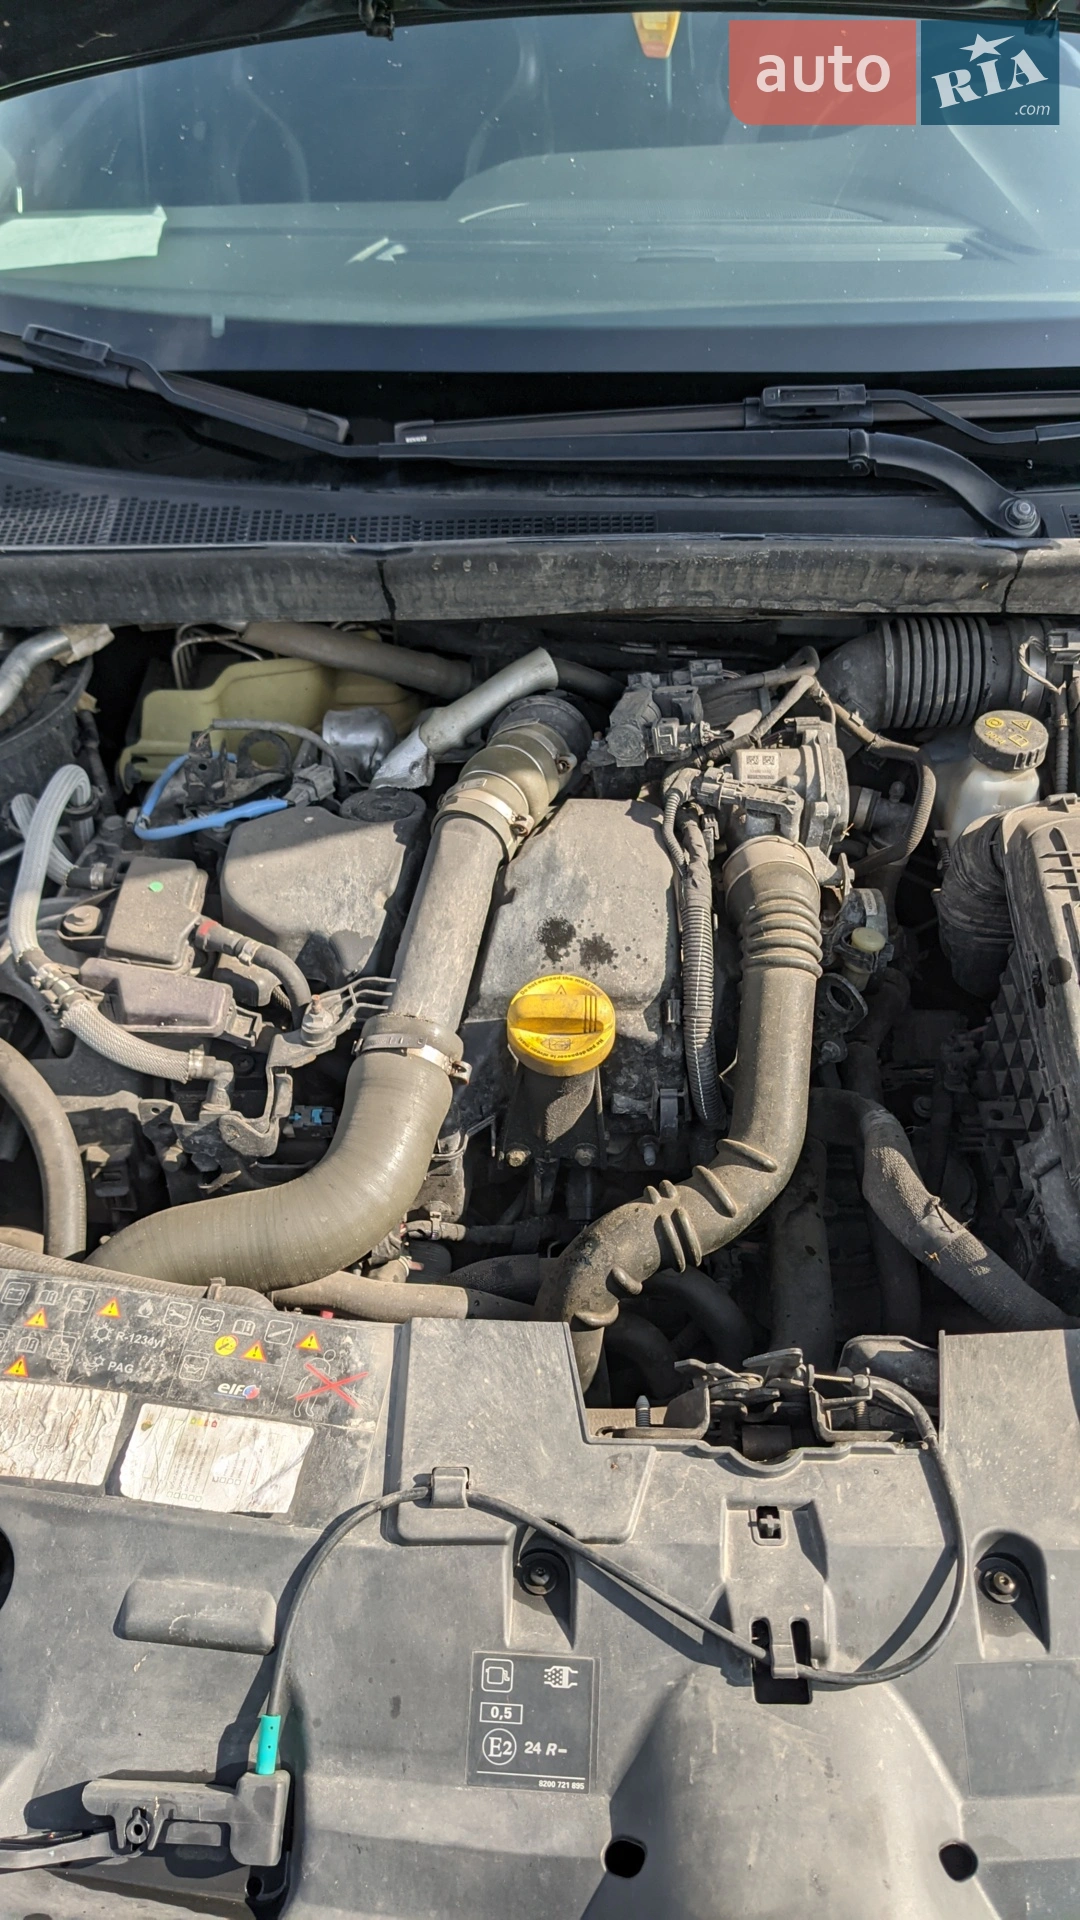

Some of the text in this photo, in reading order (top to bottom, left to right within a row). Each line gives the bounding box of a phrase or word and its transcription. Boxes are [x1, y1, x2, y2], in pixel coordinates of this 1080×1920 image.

[538, 976, 561, 984] exceed
[116, 1331, 166, 1349] R-1234yf
[107, 1361, 134, 1374] PAG
[217, 1382, 246, 1396] elf
[490, 1706, 512, 1720] 0,5
[488, 1736, 513, 1758] E2
[524, 1741, 542, 1755] 24
[538, 1779, 556, 1788] 8200
[557, 1781, 570, 1789] 721
